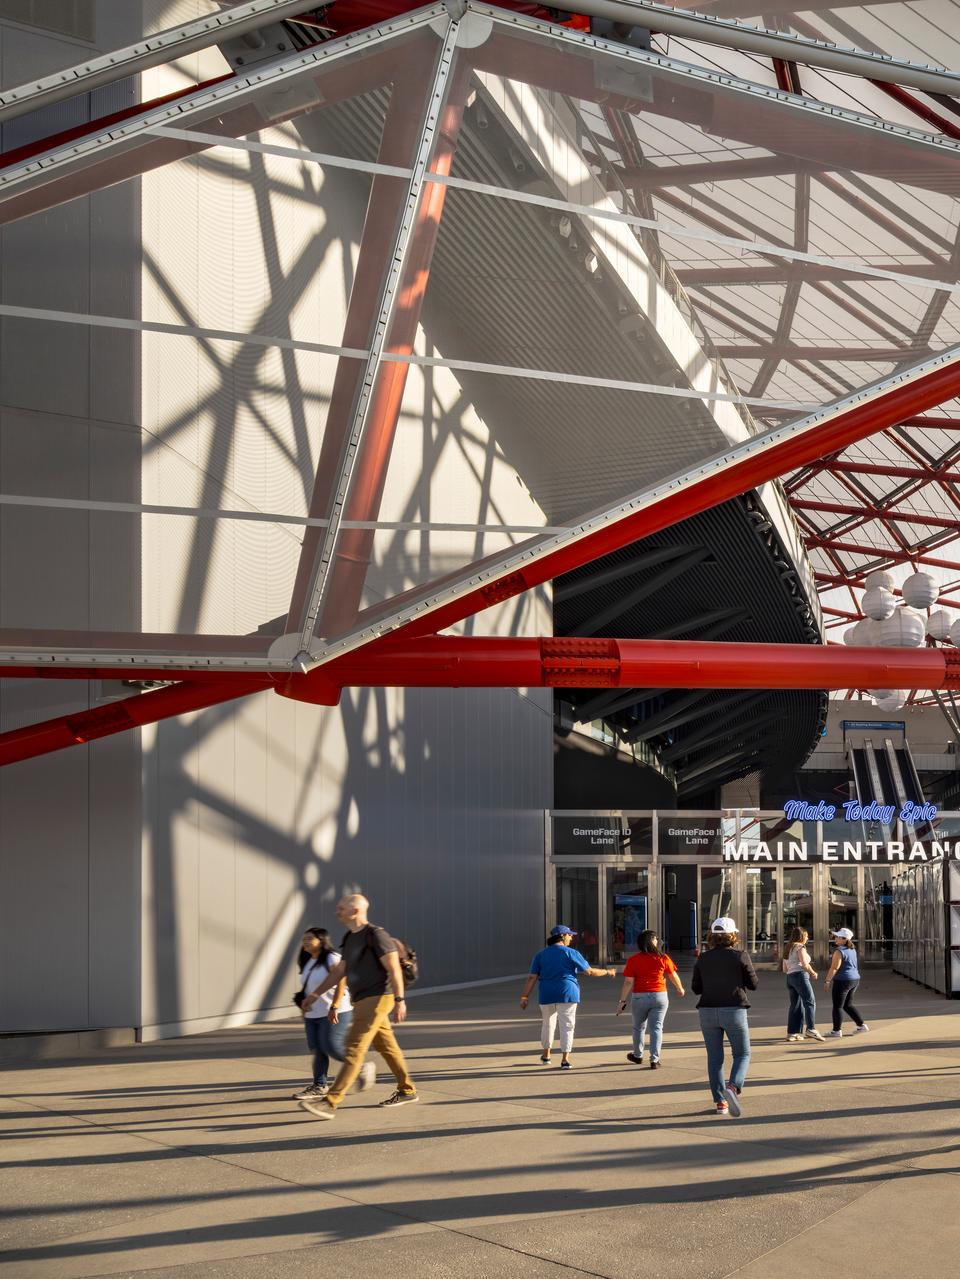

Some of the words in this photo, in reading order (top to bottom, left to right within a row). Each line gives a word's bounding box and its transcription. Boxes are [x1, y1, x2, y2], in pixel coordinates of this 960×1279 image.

[783, 800, 836, 821] Make
[843, 800, 896, 825] Today
[900, 800, 938, 825] Epic
[572, 827, 620, 836] GameFace
[621, 827, 632, 836] ID
[668, 827, 716, 836] GameFace
[590, 837, 614, 845] Lane
[685, 837, 709, 845] Lane
[724, 841, 808, 861] MAIN
